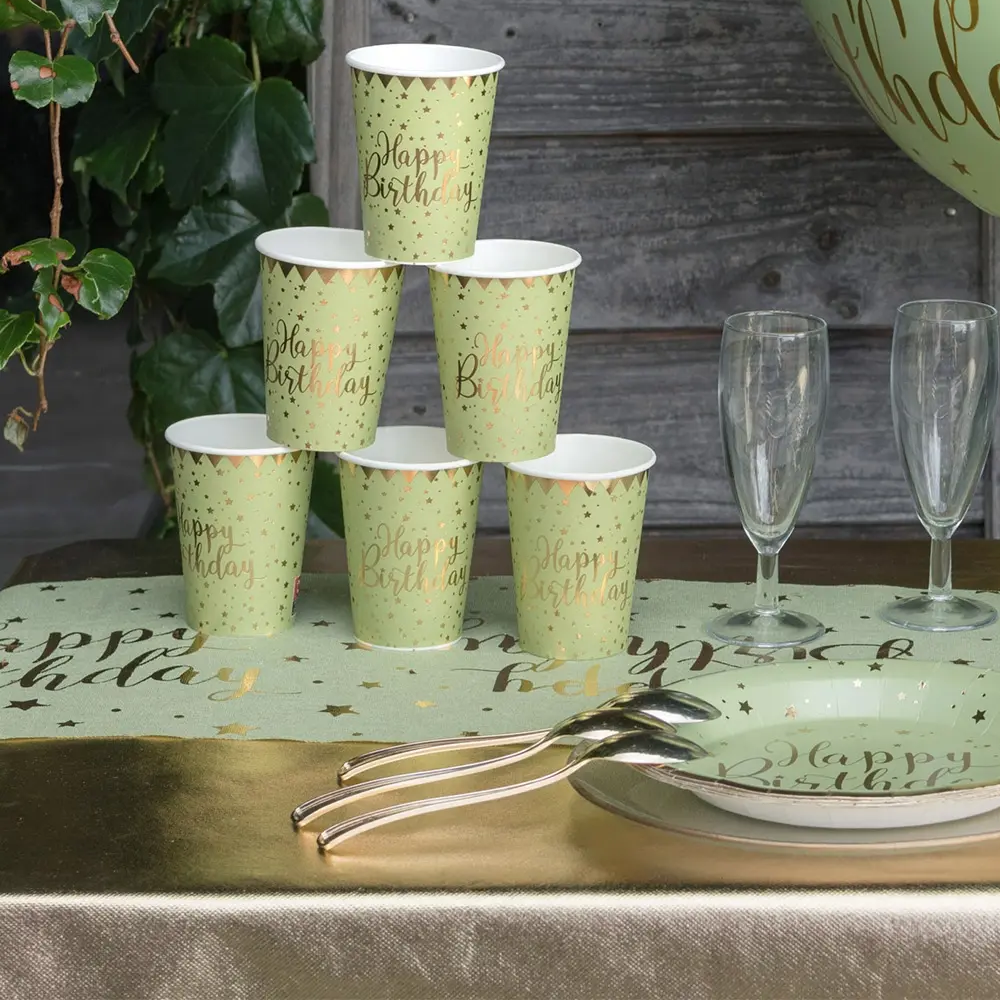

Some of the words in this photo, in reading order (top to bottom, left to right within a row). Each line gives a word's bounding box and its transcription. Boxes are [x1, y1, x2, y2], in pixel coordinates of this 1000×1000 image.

[377, 130, 469, 181] Happy
[363, 152, 477, 212] Birthday
[276, 318, 364, 372] Happy
[475, 332, 561, 374] Happy
[265, 340, 376, 405] Birthday
[457, 353, 562, 402] Birthday
[358, 544, 467, 597] Birthday
[377, 523, 465, 568] Happy
[537, 535, 625, 582] Happy
[520, 556, 632, 611] Birthday
[0, 621, 250, 663] appy
[765, 740, 1000, 775] Happy
